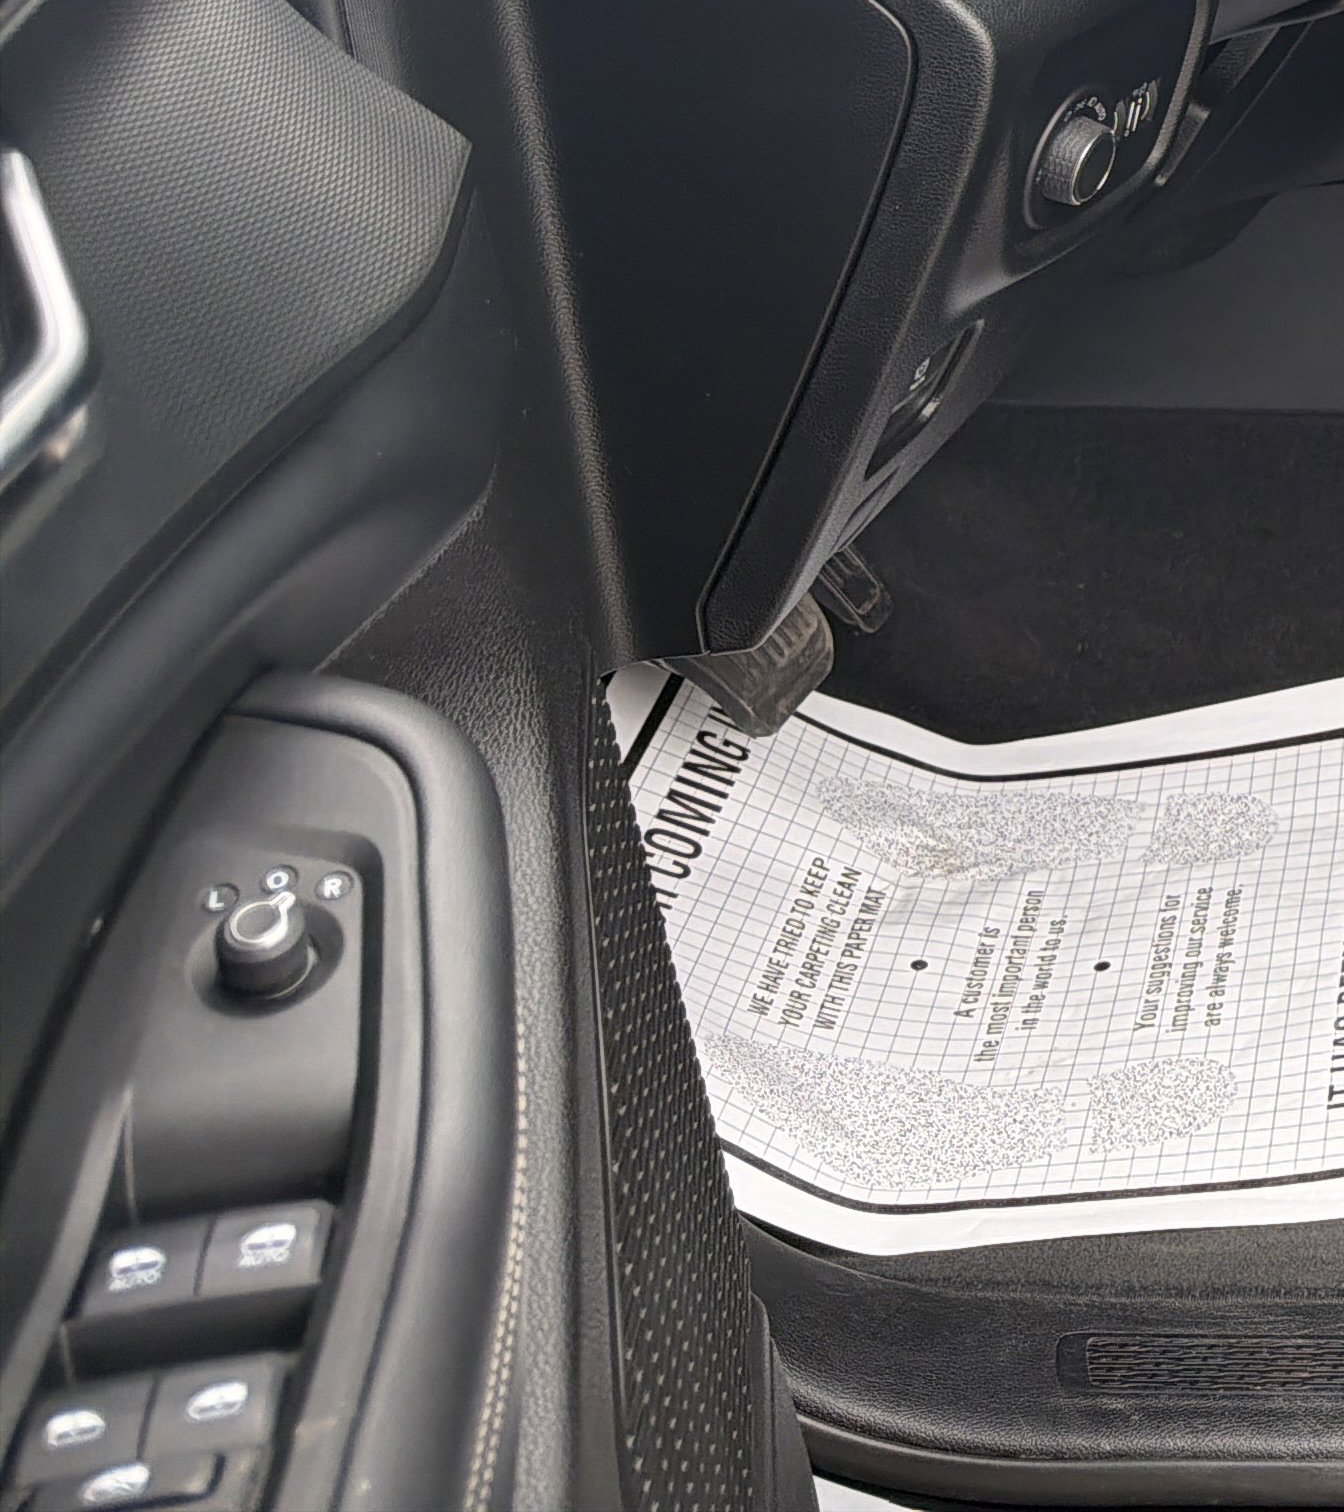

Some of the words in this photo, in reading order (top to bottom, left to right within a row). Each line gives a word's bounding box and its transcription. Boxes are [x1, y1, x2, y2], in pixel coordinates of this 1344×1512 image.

[643, 729, 751, 880] COMING
[208, 890, 225, 909] L
[323, 878, 342, 898] R
[800, 857, 830, 898] KEEP
[791, 898, 815, 917] TO
[1017, 890, 1044, 932] person
[1158, 894, 1181, 912] for
[1190, 886, 1214, 935] service
[773, 917, 806, 957] TRIED
[841, 917, 876, 960] PAPER
[978, 926, 1001, 938] is
[1048, 915, 1068, 935] us.
[777, 989, 812, 1028] YOUR
[795, 916, 841, 989] CARPETING
[825, 866, 862, 916] CLEAN
[1040, 938, 1061, 952] to
[1146, 916, 1178, 995] suggestions
[1185, 937, 1204, 958] our
[757, 957, 789, 995] HAVE
[829, 961, 858, 992] THIS
[961, 942, 996, 1004] customer
[992, 935, 1029, 998] important
[1032, 955, 1058, 991] world
[1205, 951, 1236, 998] always
[747, 993, 775, 1016] WE
[813, 994, 845, 1030] WITH
[953, 1007, 976, 1018] A
[1021, 994, 1046, 1014] the
[1165, 961, 1203, 1033] improving
[986, 1001, 1011, 1034] most
[1015, 1017, 1040, 1031] in
[1133, 998, 1160, 1031] Your
[1204, 1002, 1223, 1027] are
[973, 1039, 999, 1062] the
